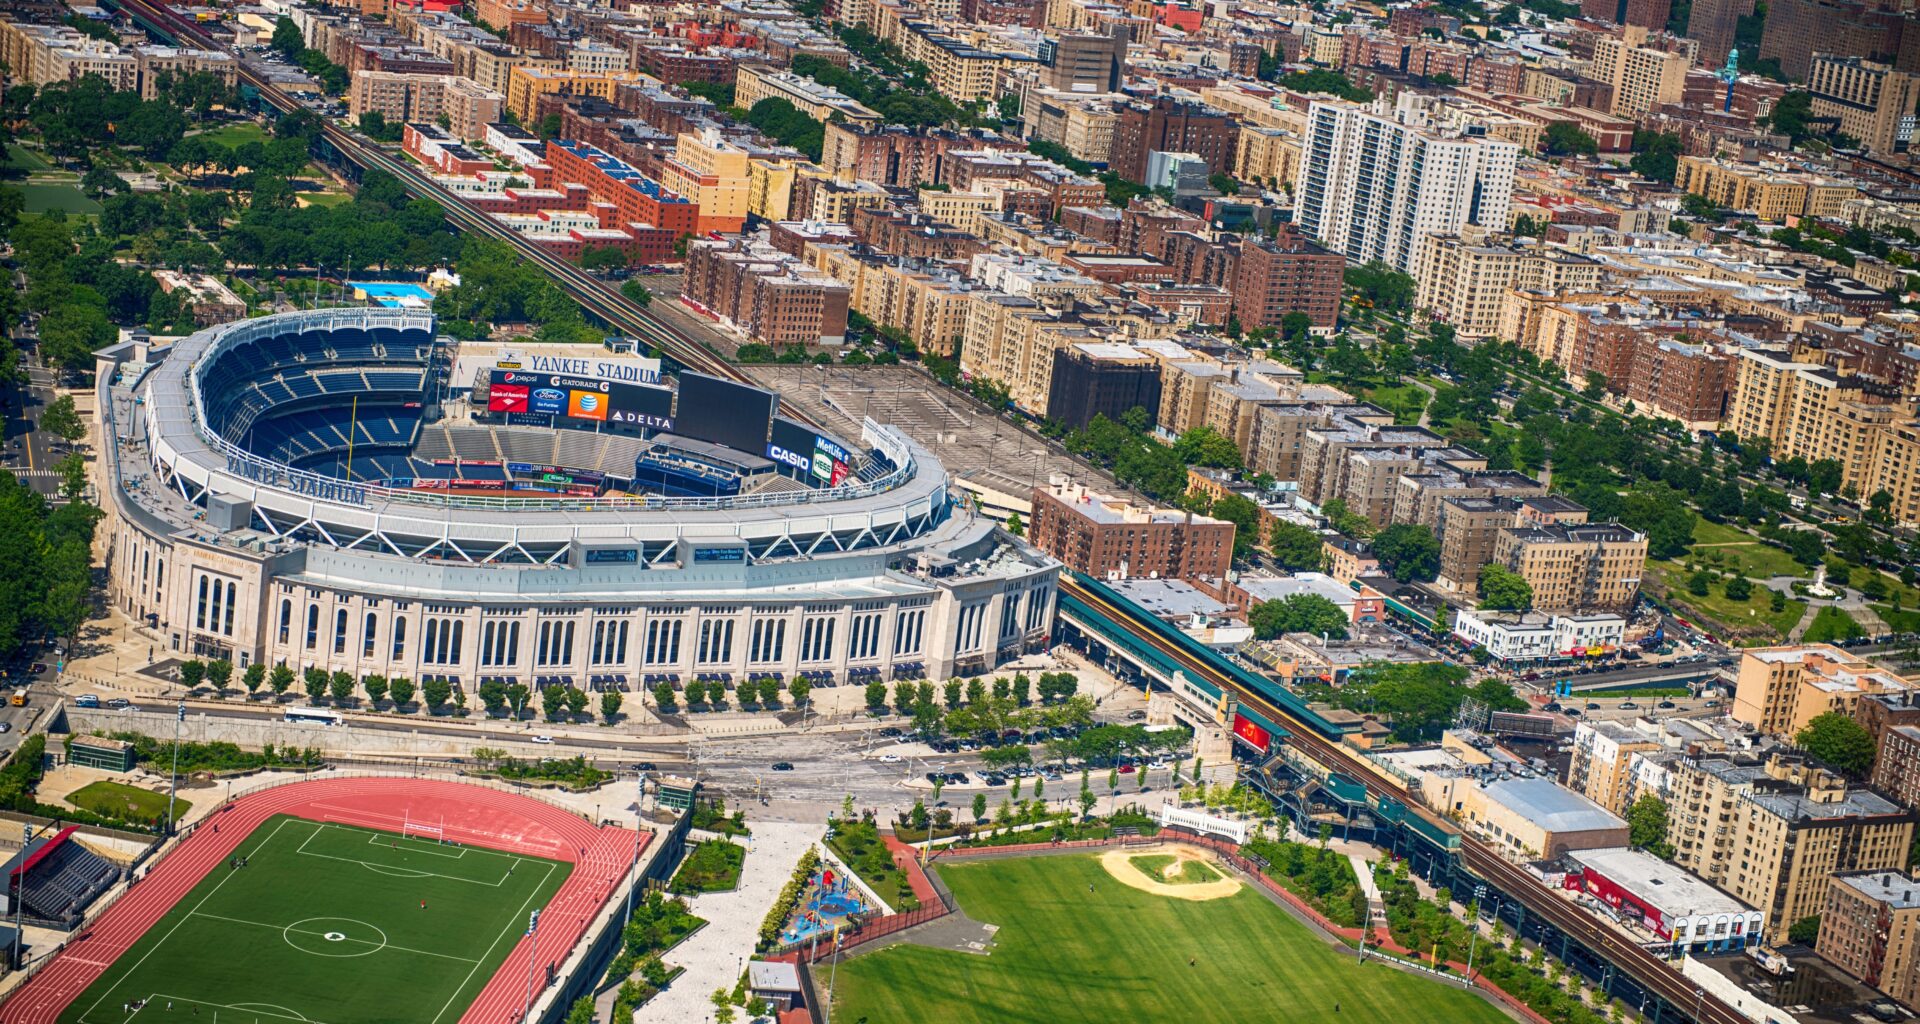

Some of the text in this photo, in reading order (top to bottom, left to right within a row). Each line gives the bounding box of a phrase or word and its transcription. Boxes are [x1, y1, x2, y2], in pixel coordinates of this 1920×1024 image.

[531, 355, 662, 385] YANKEE STADIUM
[516, 375, 537, 383] pepsi
[562, 379, 597, 389] GATORADE
[539, 391, 559, 400] Ford
[627, 413, 671, 429] DELTA
[817, 437, 843, 460] MetLife
[771, 446, 809, 470] CASIO
[814, 458, 832, 474] HESS
[226, 454, 366, 505] YANKEE STADIUM
